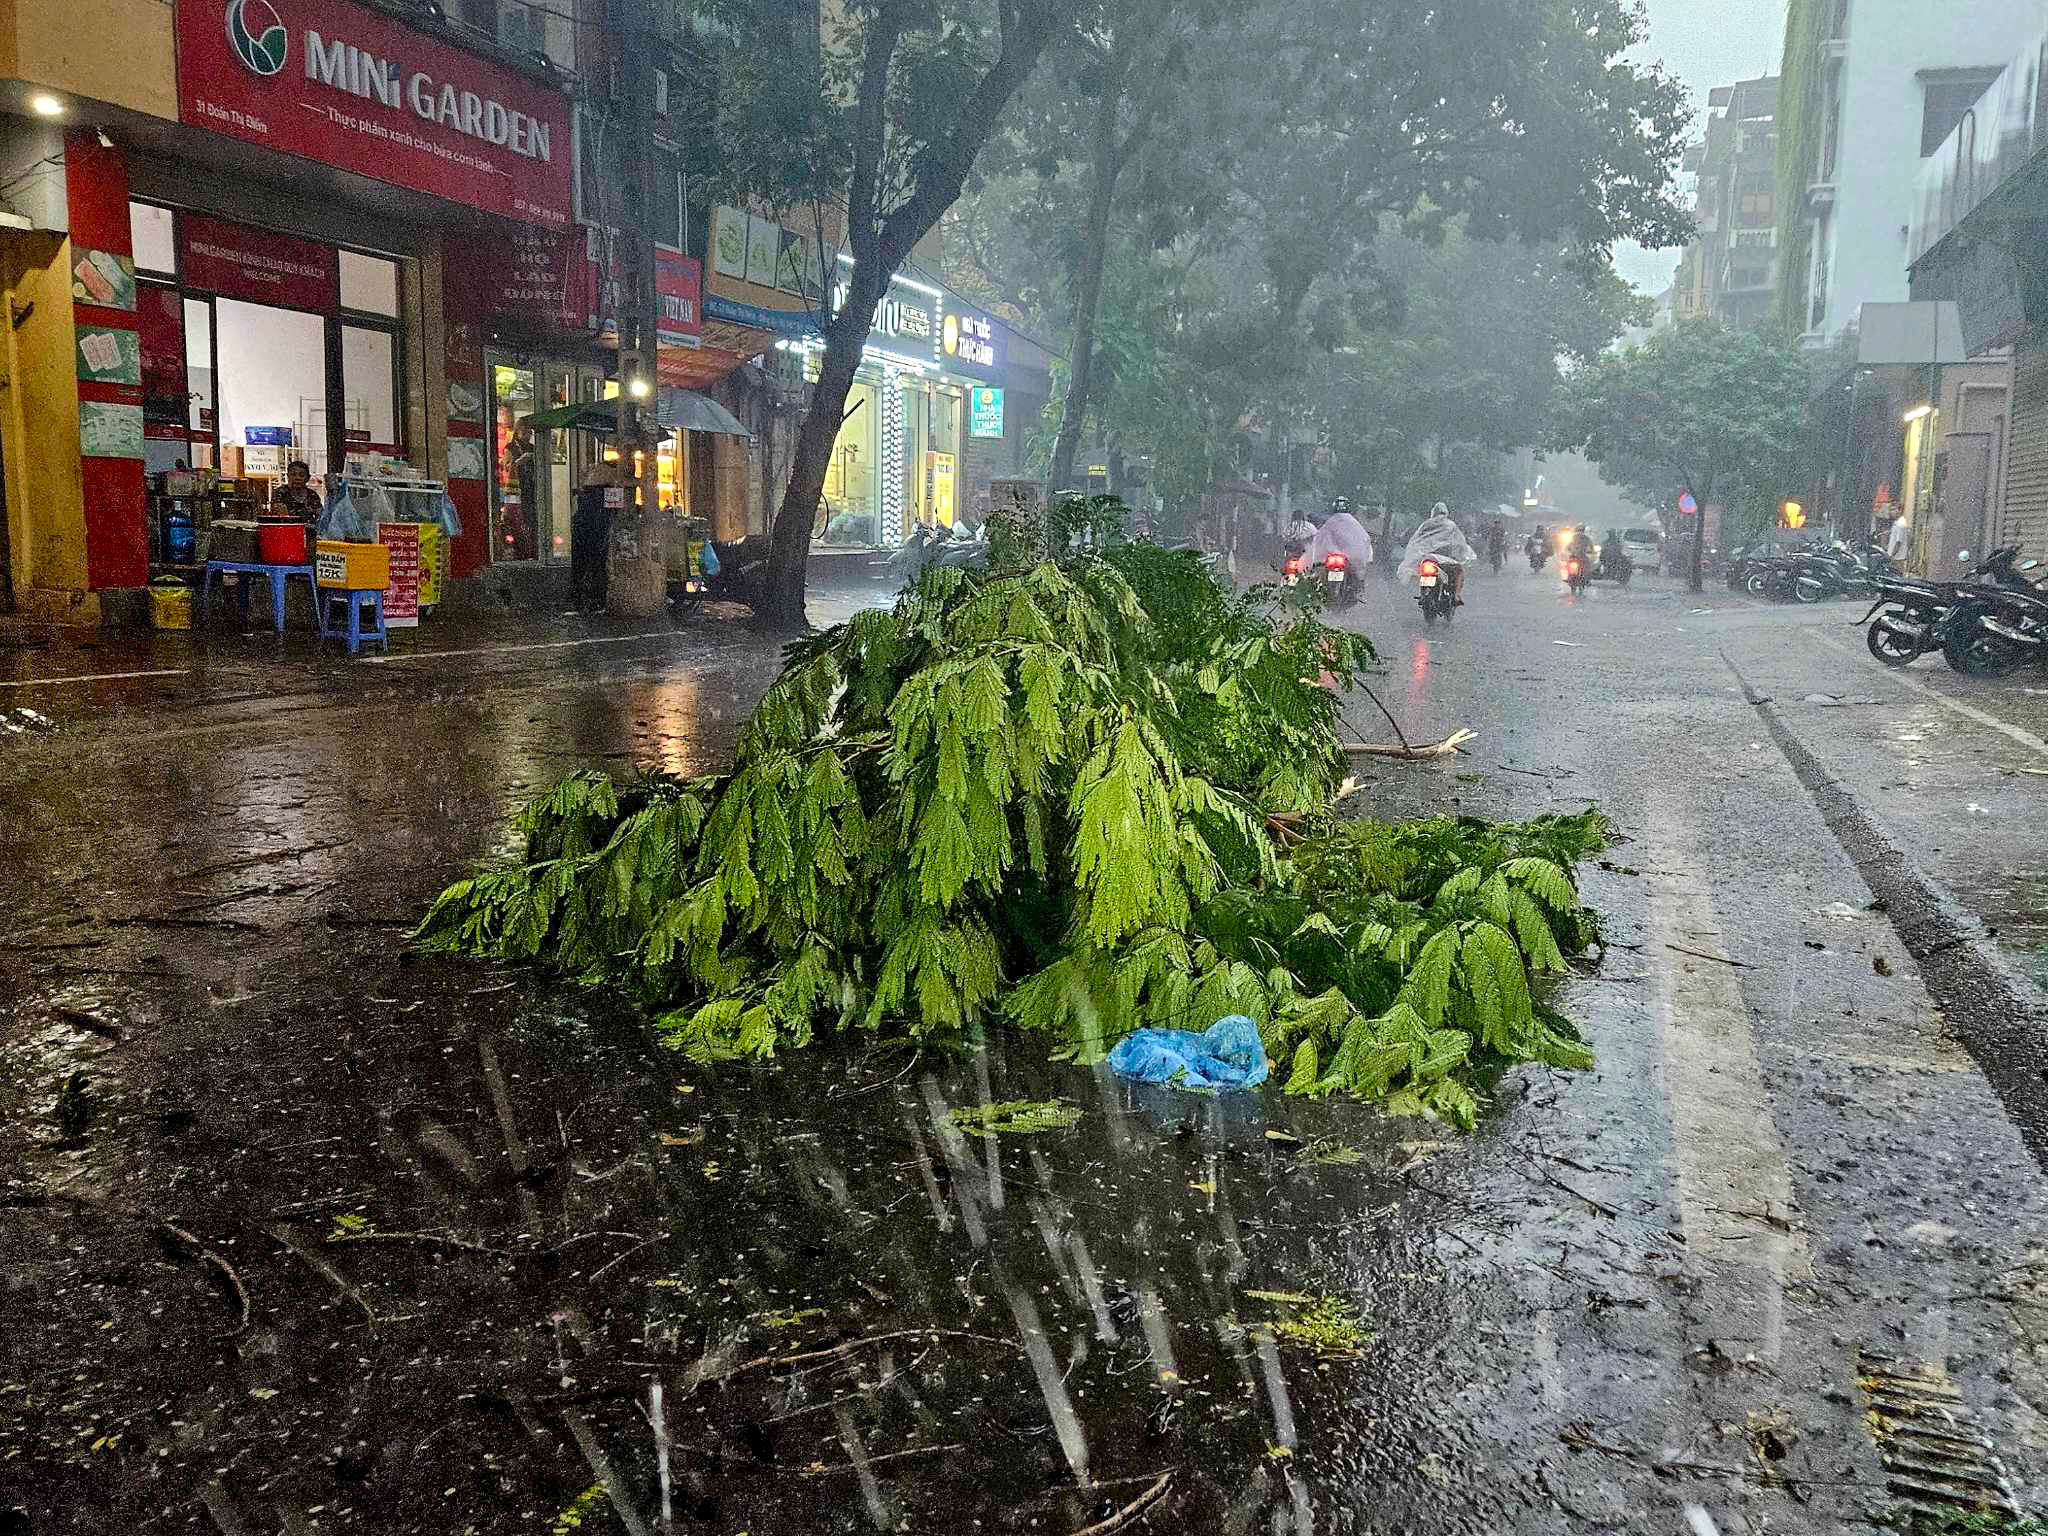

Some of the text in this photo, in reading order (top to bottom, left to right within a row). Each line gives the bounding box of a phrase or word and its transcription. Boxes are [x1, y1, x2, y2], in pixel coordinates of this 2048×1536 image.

[196, 100, 206, 114] 31
[408, 72, 550, 163] GARDEN
[326, 105, 357, 129] Thực
[359, 119, 388, 139] phẩm
[389, 128, 413, 146] xanh
[414, 136, 432, 152] cho
[980, 403, 995, 412] NHÀ
[318, 567, 341, 579] 15K
